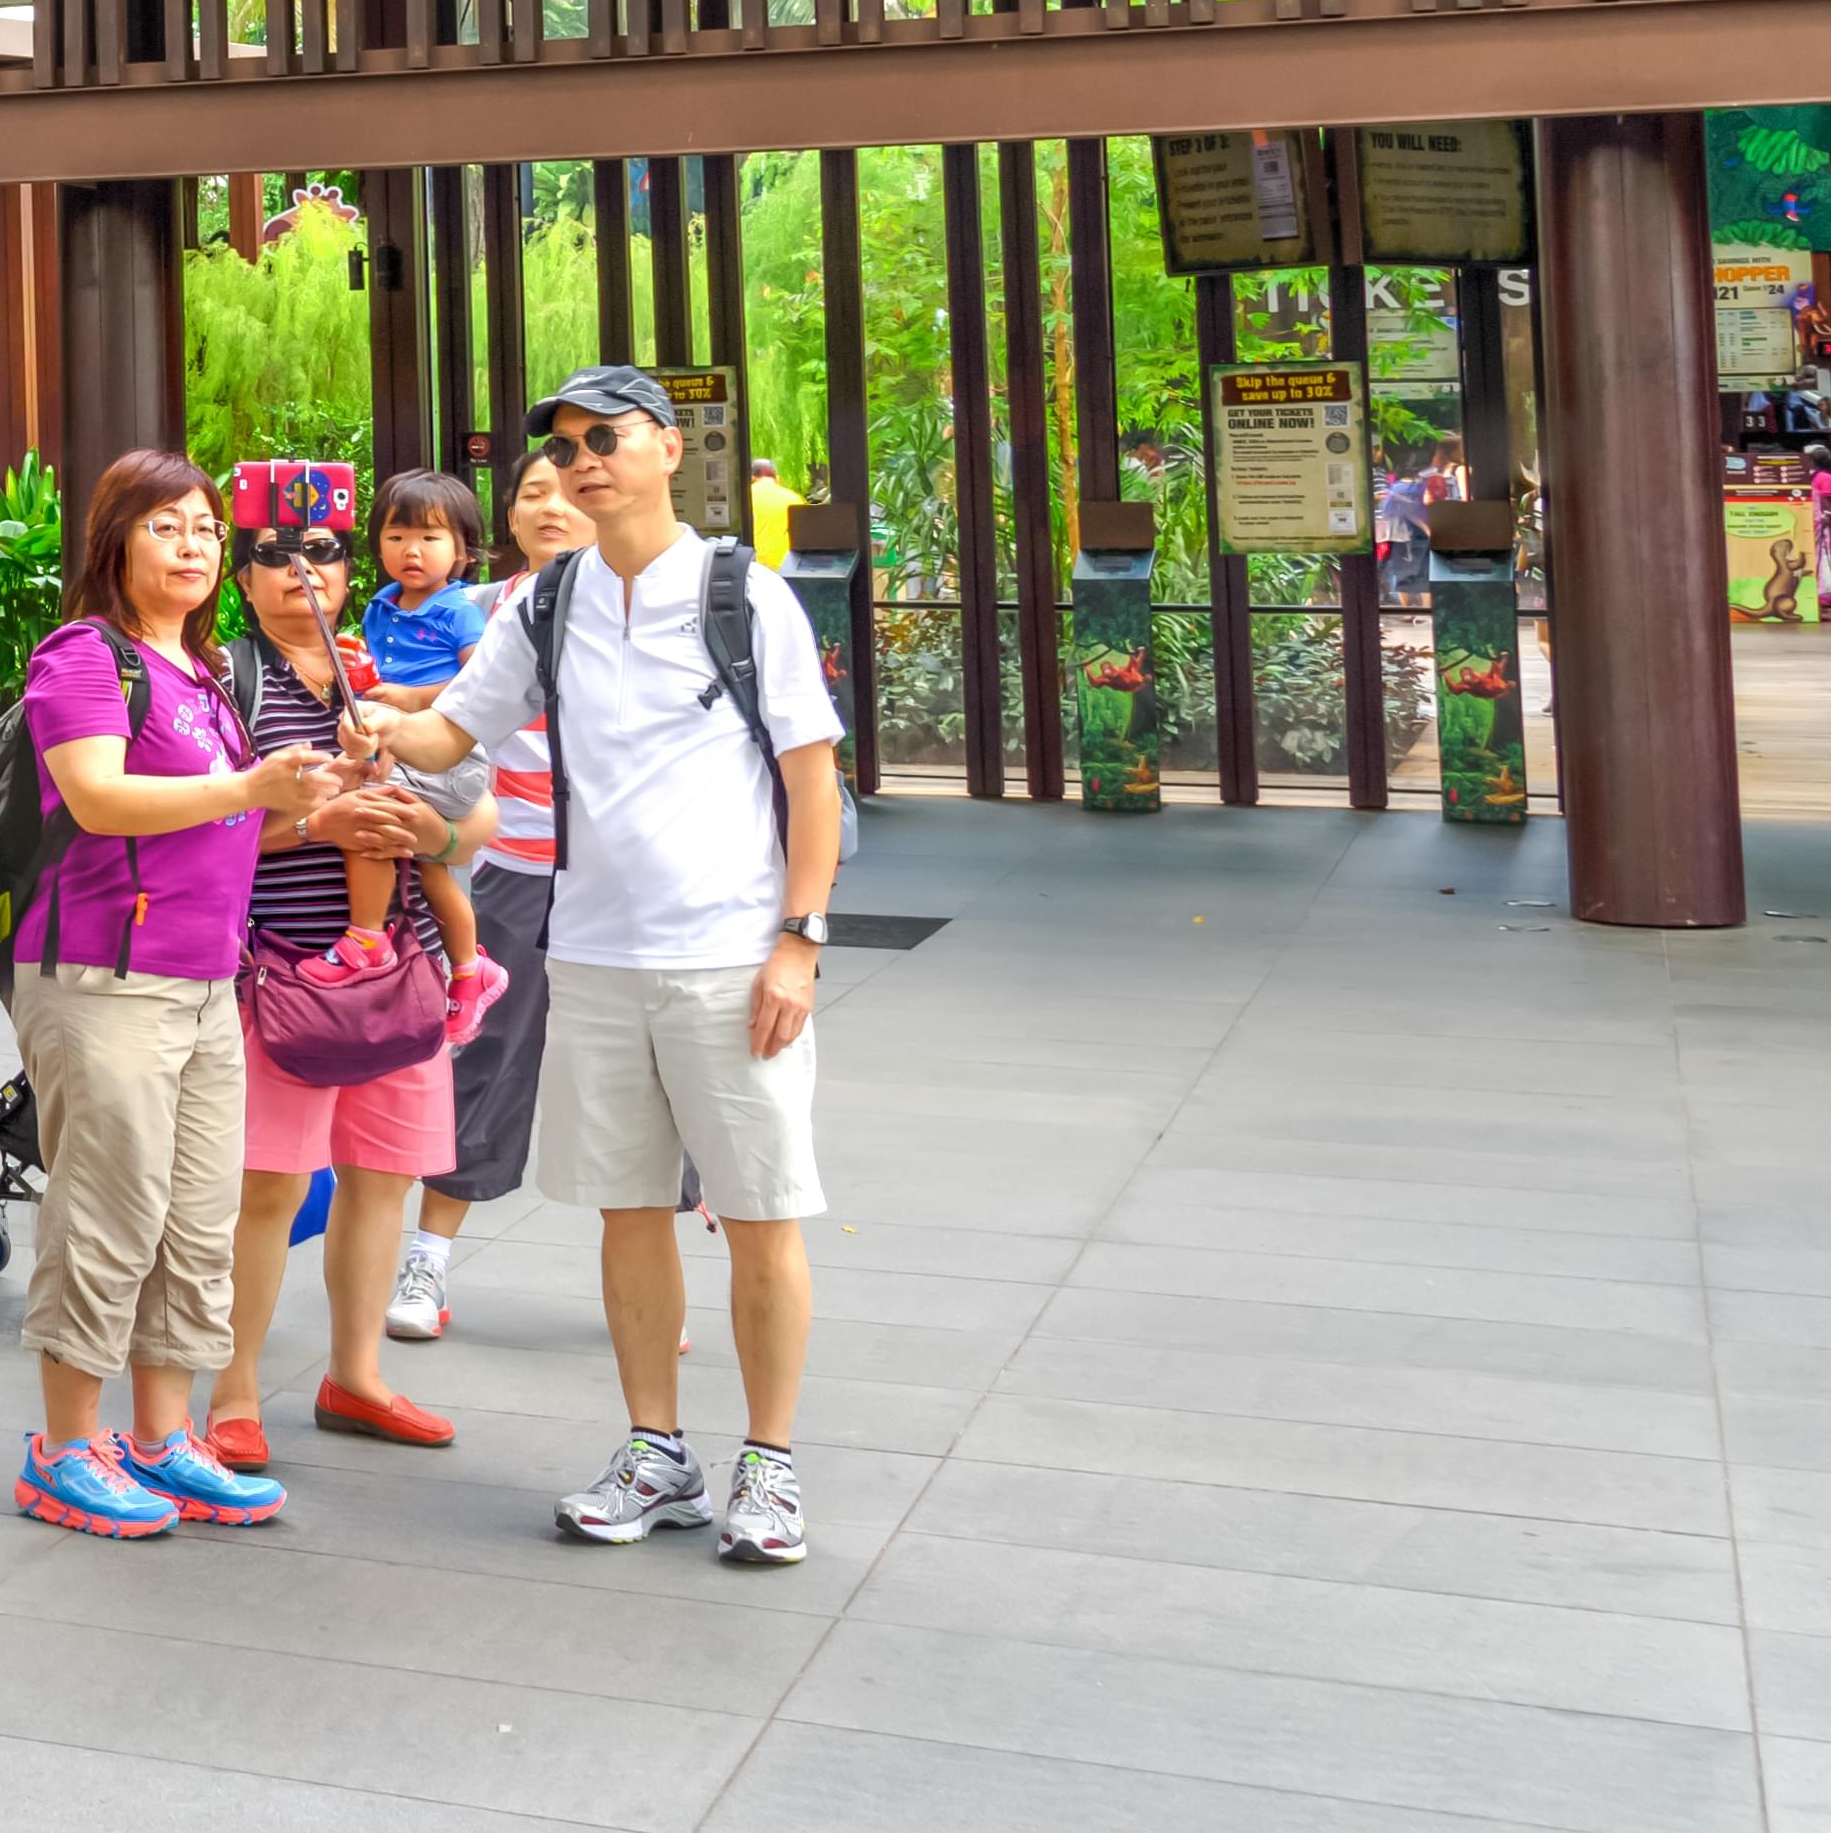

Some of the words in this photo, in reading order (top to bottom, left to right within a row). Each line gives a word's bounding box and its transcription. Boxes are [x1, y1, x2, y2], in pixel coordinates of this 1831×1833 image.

[1169, 139, 1191, 157] STEP
[1371, 132, 1393, 150] YOU
[1396, 133, 1425, 151] WILL
[1236, 376, 1262, 389] Skip
[1266, 375, 1285, 386] the
[1288, 375, 1324, 387] queue
[1242, 391, 1269, 401] save
[1272, 390, 1287, 401] up
[1228, 409, 1245, 417] GET
[1248, 408, 1273, 417] YOUR
[1275, 408, 1313, 416] TICKETS
[1228, 418, 1275, 429] ONLINE
[1278, 417, 1315, 429] NOW!
